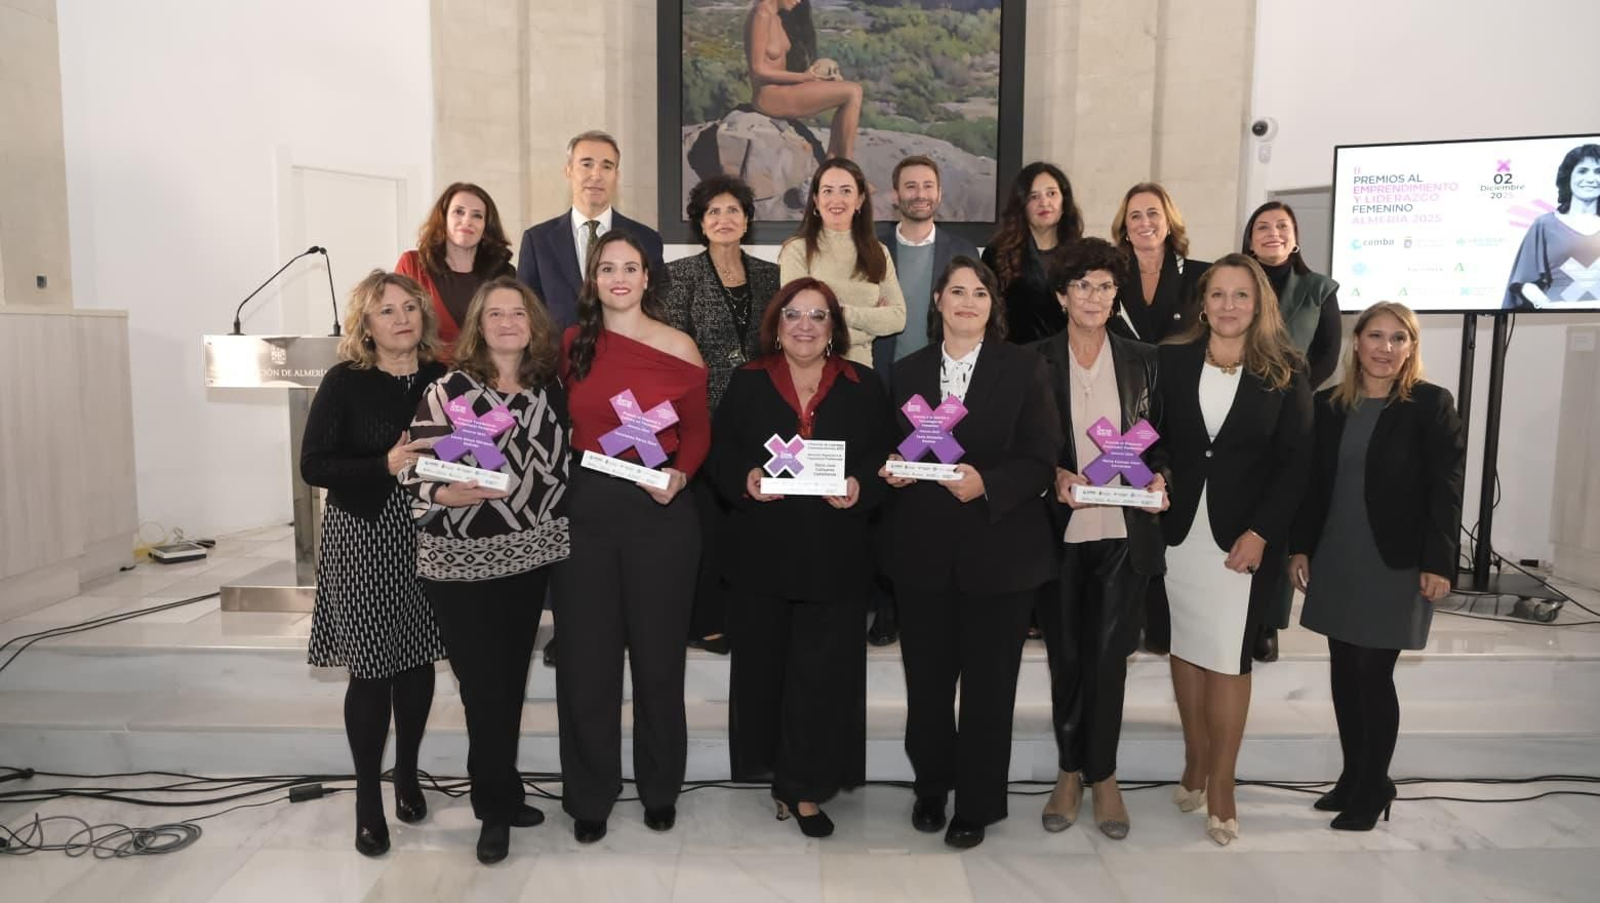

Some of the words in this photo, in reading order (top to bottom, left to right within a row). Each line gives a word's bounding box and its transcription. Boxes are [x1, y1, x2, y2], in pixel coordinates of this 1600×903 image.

[1353, 175, 1405, 185] PREMIOS
[1408, 173, 1423, 183] AL
[1493, 173, 1513, 184] 02
[1353, 182, 1459, 194] EMPRENDIMIENTO
[1480, 184, 1525, 192] Diciembre
[1354, 195, 1362, 203] Y
[1365, 193, 1440, 203] LIDERAZGO
[1352, 204, 1413, 214] FEMENINO
[1412, 213, 1442, 224] 2025
[281, 369, 293, 377] DE
